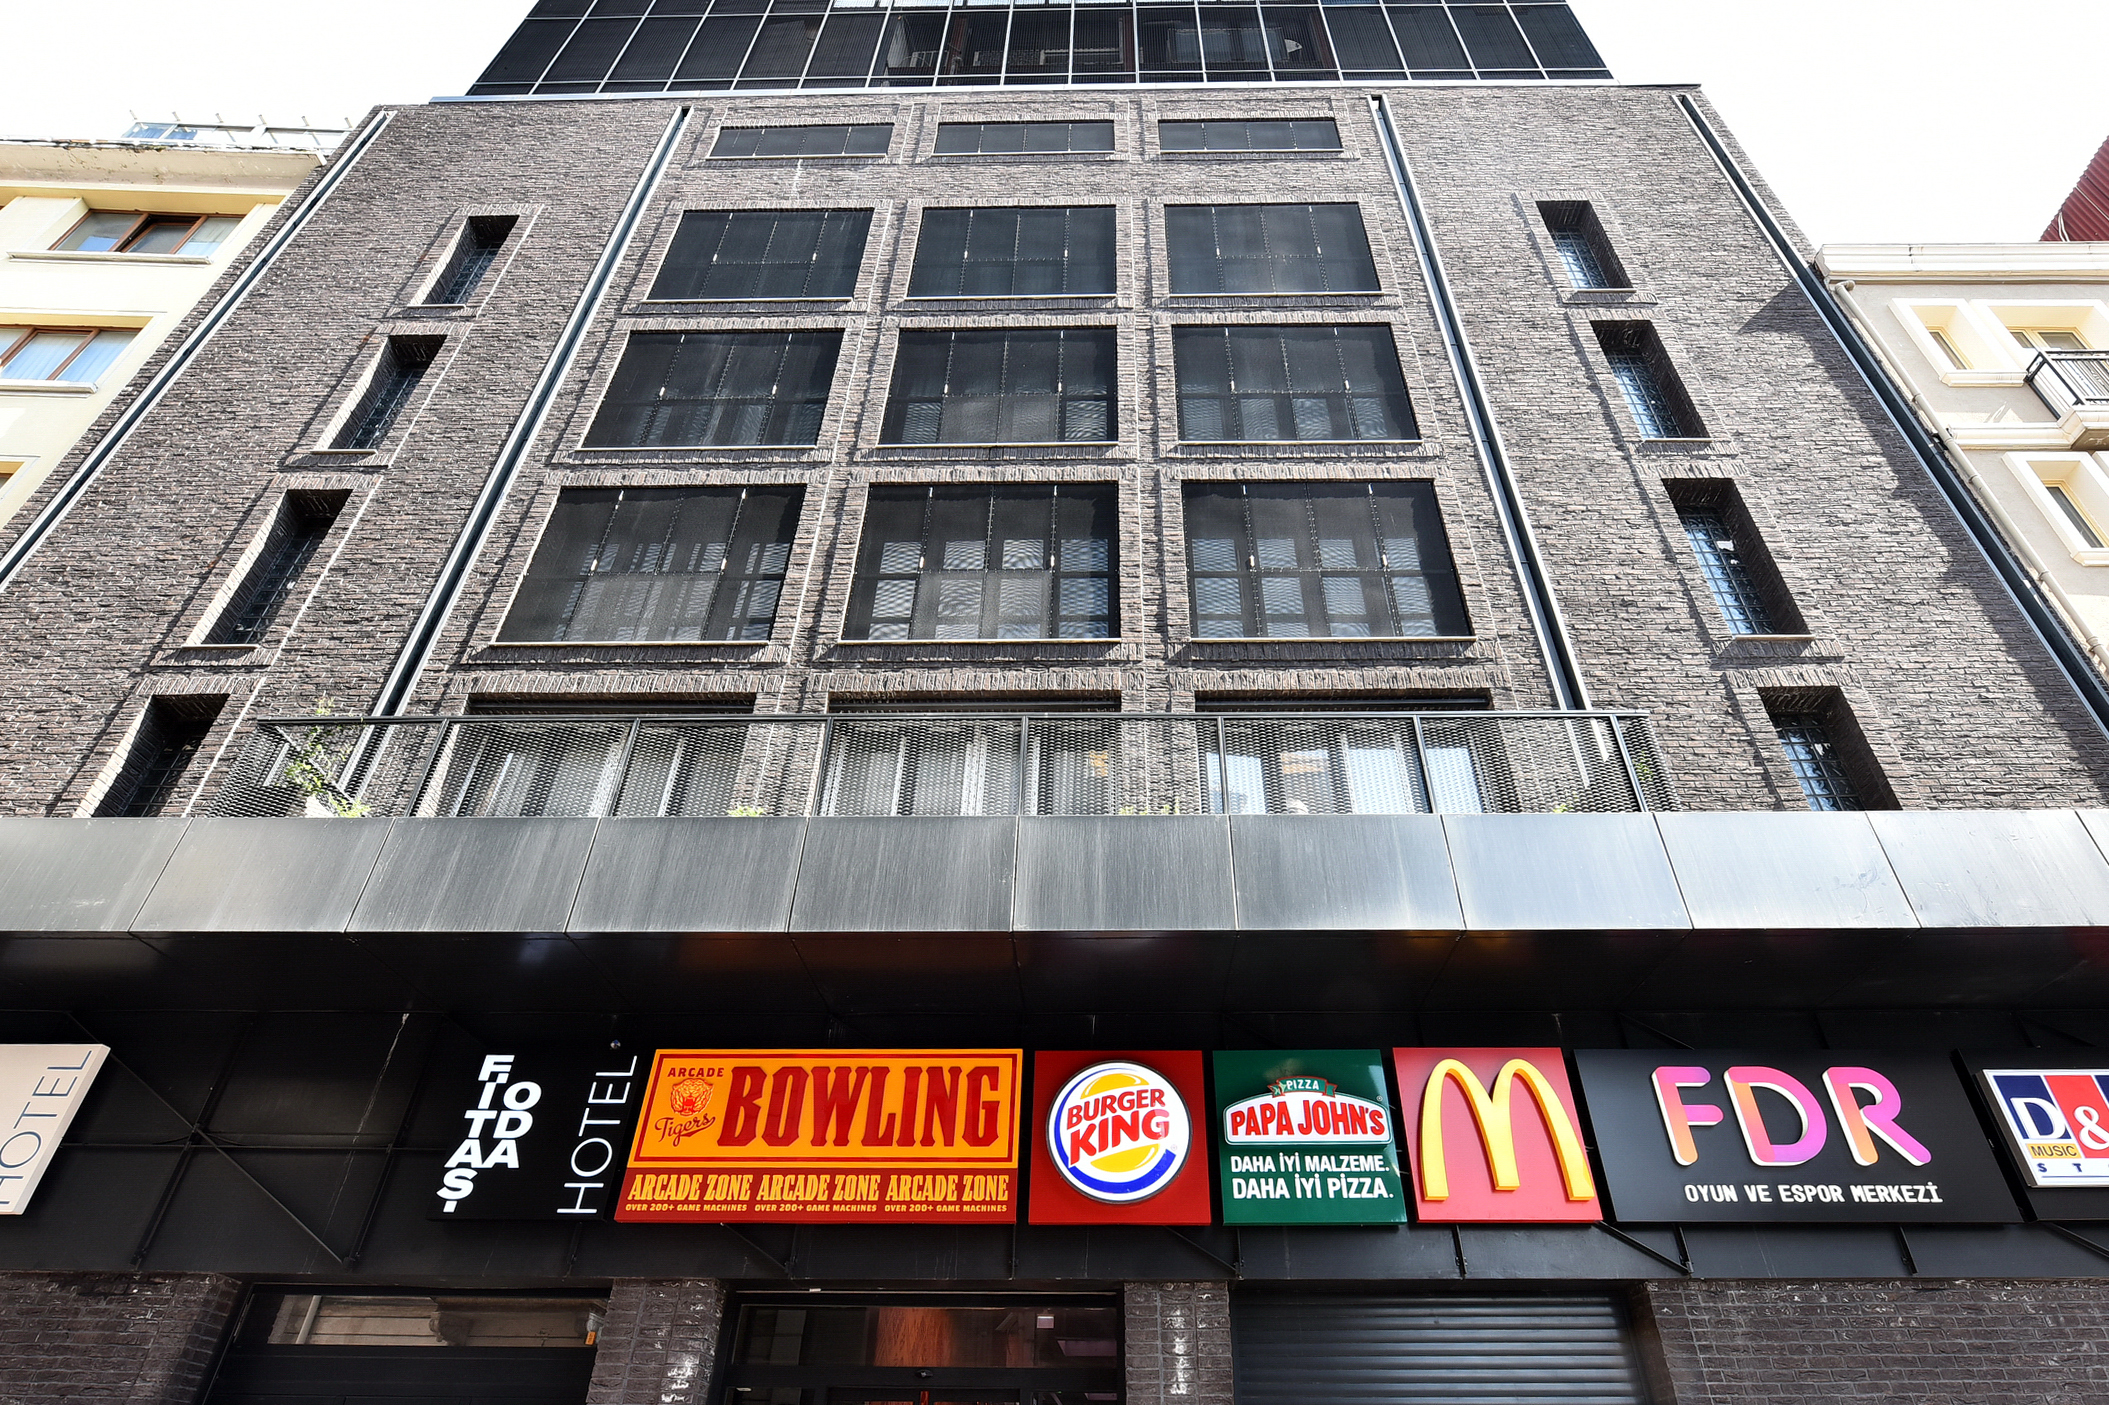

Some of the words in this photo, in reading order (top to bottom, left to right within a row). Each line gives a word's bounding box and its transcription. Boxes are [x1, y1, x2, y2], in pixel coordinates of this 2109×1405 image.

[667, 1068, 724, 1077] ARCADE
[1286, 1079, 1320, 1091] PIZZA
[717, 1066, 1000, 1147] BOWLING
[1067, 1088, 1166, 1130] BURGER
[1230, 1101, 1295, 1136] PAPA
[1297, 1100, 1385, 1136] JOHN'S
[1651, 1065, 1932, 1167] FDR
[557, 1055, 637, 1214] HOTEL
[654, 1113, 716, 1147] Tigers
[1070, 1109, 1170, 1165] KING
[1421, 1058, 1595, 1201] M
[1230, 1155, 1276, 1172] DAHA
[1279, 1152, 1301, 1172] İYİ
[1304, 1155, 1390, 1172] MALZEME.
[2030, 1145, 2077, 1157] MUSIC
[627, 1174, 703, 1201] ARCADE
[703, 1174, 753, 1201] ZONE
[756, 1174, 831, 1201] ARCADE
[832, 1174, 881, 1201] ZONE
[885, 1174, 958, 1201] ARCADE
[962, 1174, 1009, 1201] ZONE
[1232, 1177, 1290, 1199] DAHA
[1294, 1173, 1322, 1199] İYİ
[1327, 1173, 1394, 1199] PİZZA.
[1684, 1184, 1738, 1203] OYUN
[1743, 1184, 1772, 1203] VE
[1777, 1184, 1845, 1203] ESPOR
[1849, 1181, 1943, 1203] MERKEZİ
[625, 1203, 648, 1212] OVER
[650, 1203, 675, 1212] 200+
[677, 1203, 701, 1212] GAME
[703, 1203, 747, 1212] MACHINES
[754, 1203, 777, 1212] OVER
[779, 1203, 804, 1212] 200+
[806, 1203, 830, 1212] GAME
[833, 1203, 877, 1212] MACHINES
[884, 1203, 907, 1212] OVER
[909, 1203, 934, 1212] 200+
[936, 1203, 961, 1212] GAME
[963, 1203, 1007, 1212] MACHINES
